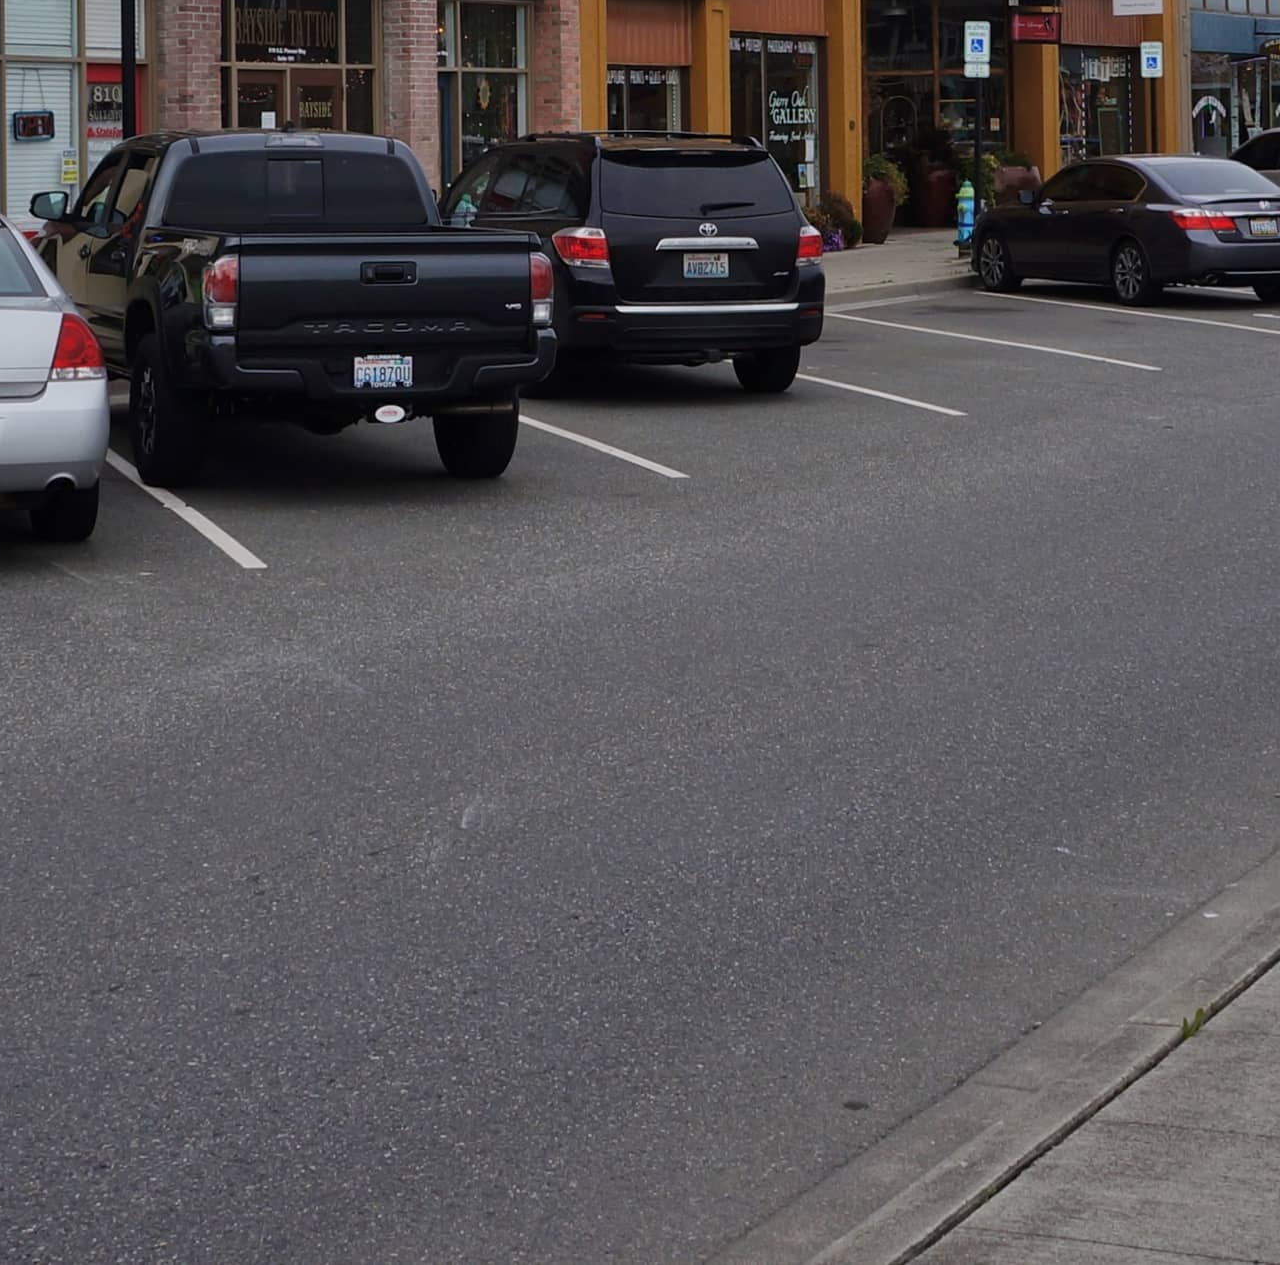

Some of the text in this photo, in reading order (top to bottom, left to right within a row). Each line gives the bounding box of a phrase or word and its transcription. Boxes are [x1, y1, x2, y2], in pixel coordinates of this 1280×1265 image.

[235, 7, 337, 48] BAYSIDE TATTOO
[93, 85, 122, 103] 810
[299, 100, 333, 119] BAYSIDE
[772, 107, 817, 125] GALLERY
[304, 321, 470, 334] TACOMA
[356, 366, 411, 383] C61870U
